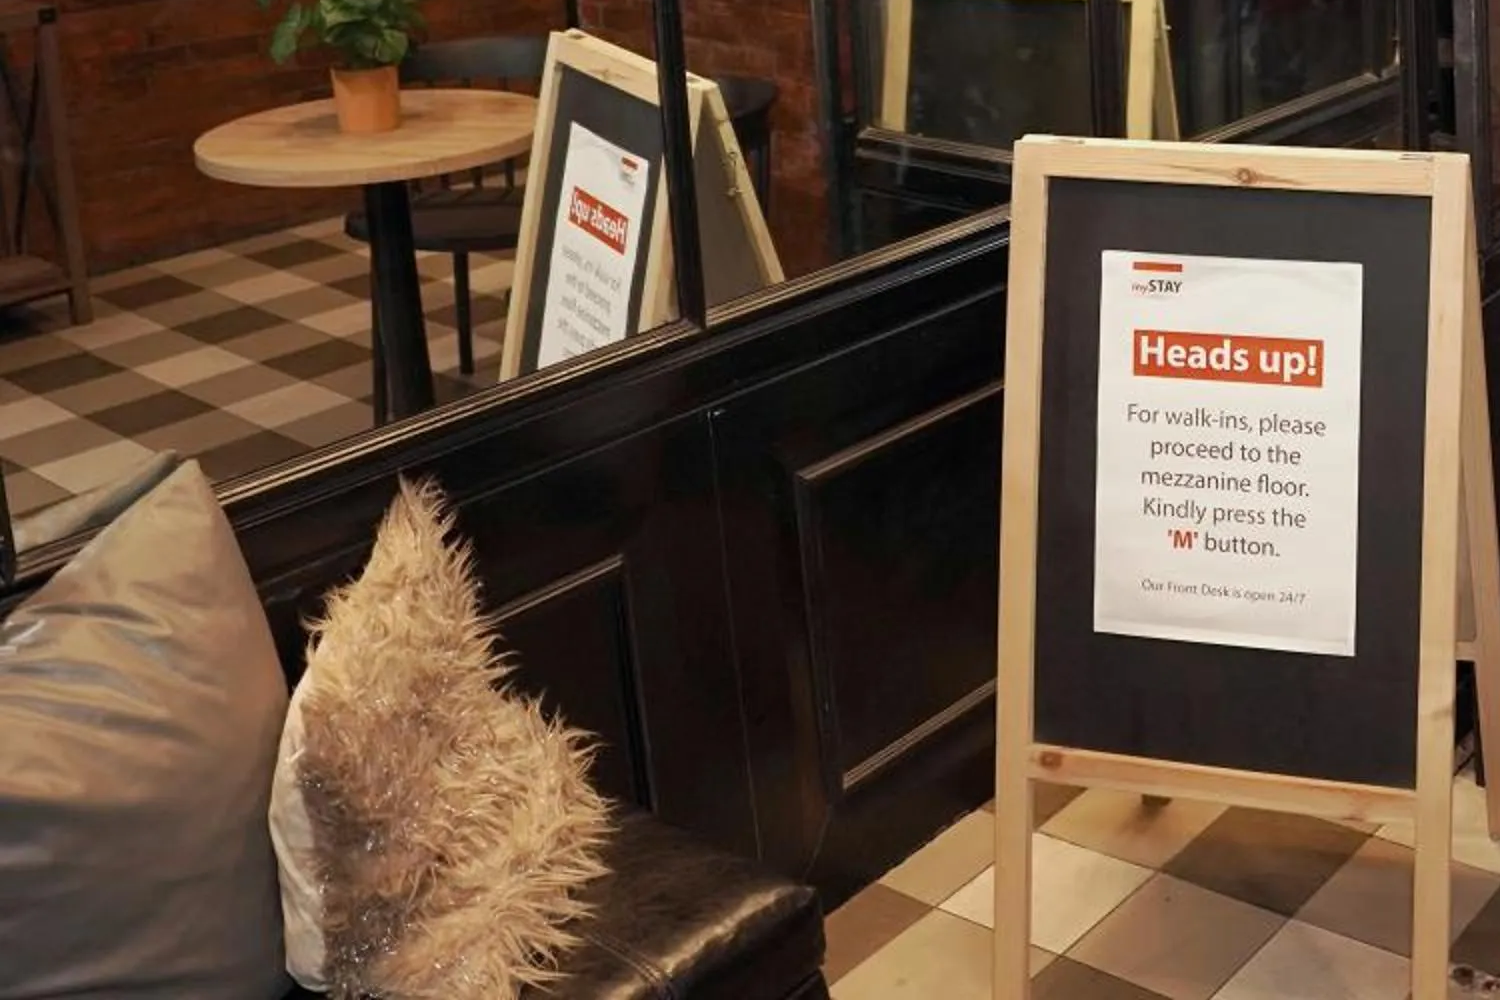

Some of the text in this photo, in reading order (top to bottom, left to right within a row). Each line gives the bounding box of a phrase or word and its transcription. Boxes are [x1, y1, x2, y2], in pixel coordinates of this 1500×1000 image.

[1139, 335, 1318, 383] Heads up!
[1127, 403, 1327, 437] For walk-ins, please
[1151, 440, 1302, 465] proceed to the
[1141, 470, 1309, 497] mezzanine floor.
[1143, 496, 1307, 528] Kindly press the
[1168, 529, 1281, 557] 'M' button.
[1141, 578, 1306, 605] Our Front Desk is open 24/7
